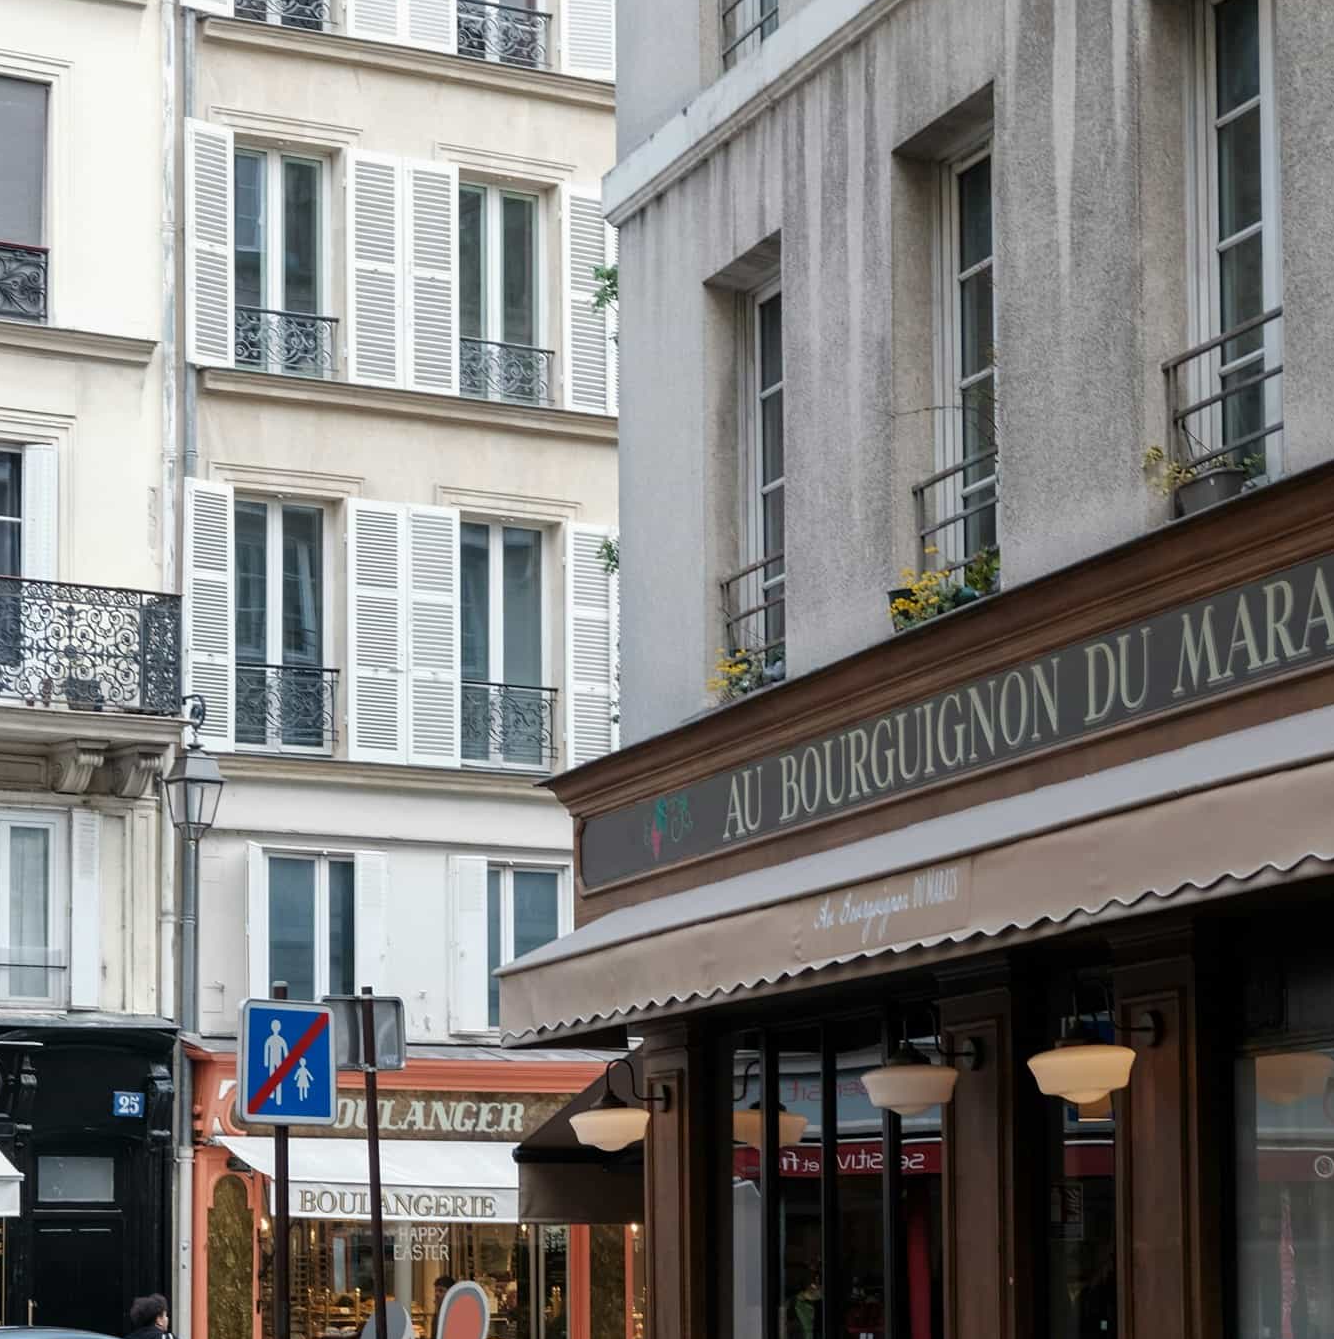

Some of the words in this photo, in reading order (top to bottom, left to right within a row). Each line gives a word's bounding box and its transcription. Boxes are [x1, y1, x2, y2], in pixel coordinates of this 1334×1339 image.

[722, 765, 764, 842] AU
[778, 657, 1060, 824] BOURGUIGNON
[1083, 626, 1152, 726] DU
[117, 1094, 140, 1115] 25
[332, 1096, 525, 1134] OULANGER
[298, 1188, 497, 1218] BOULANGERIE
[398, 1226, 450, 1243] HAPPY
[393, 1244, 451, 1262] EASTER
